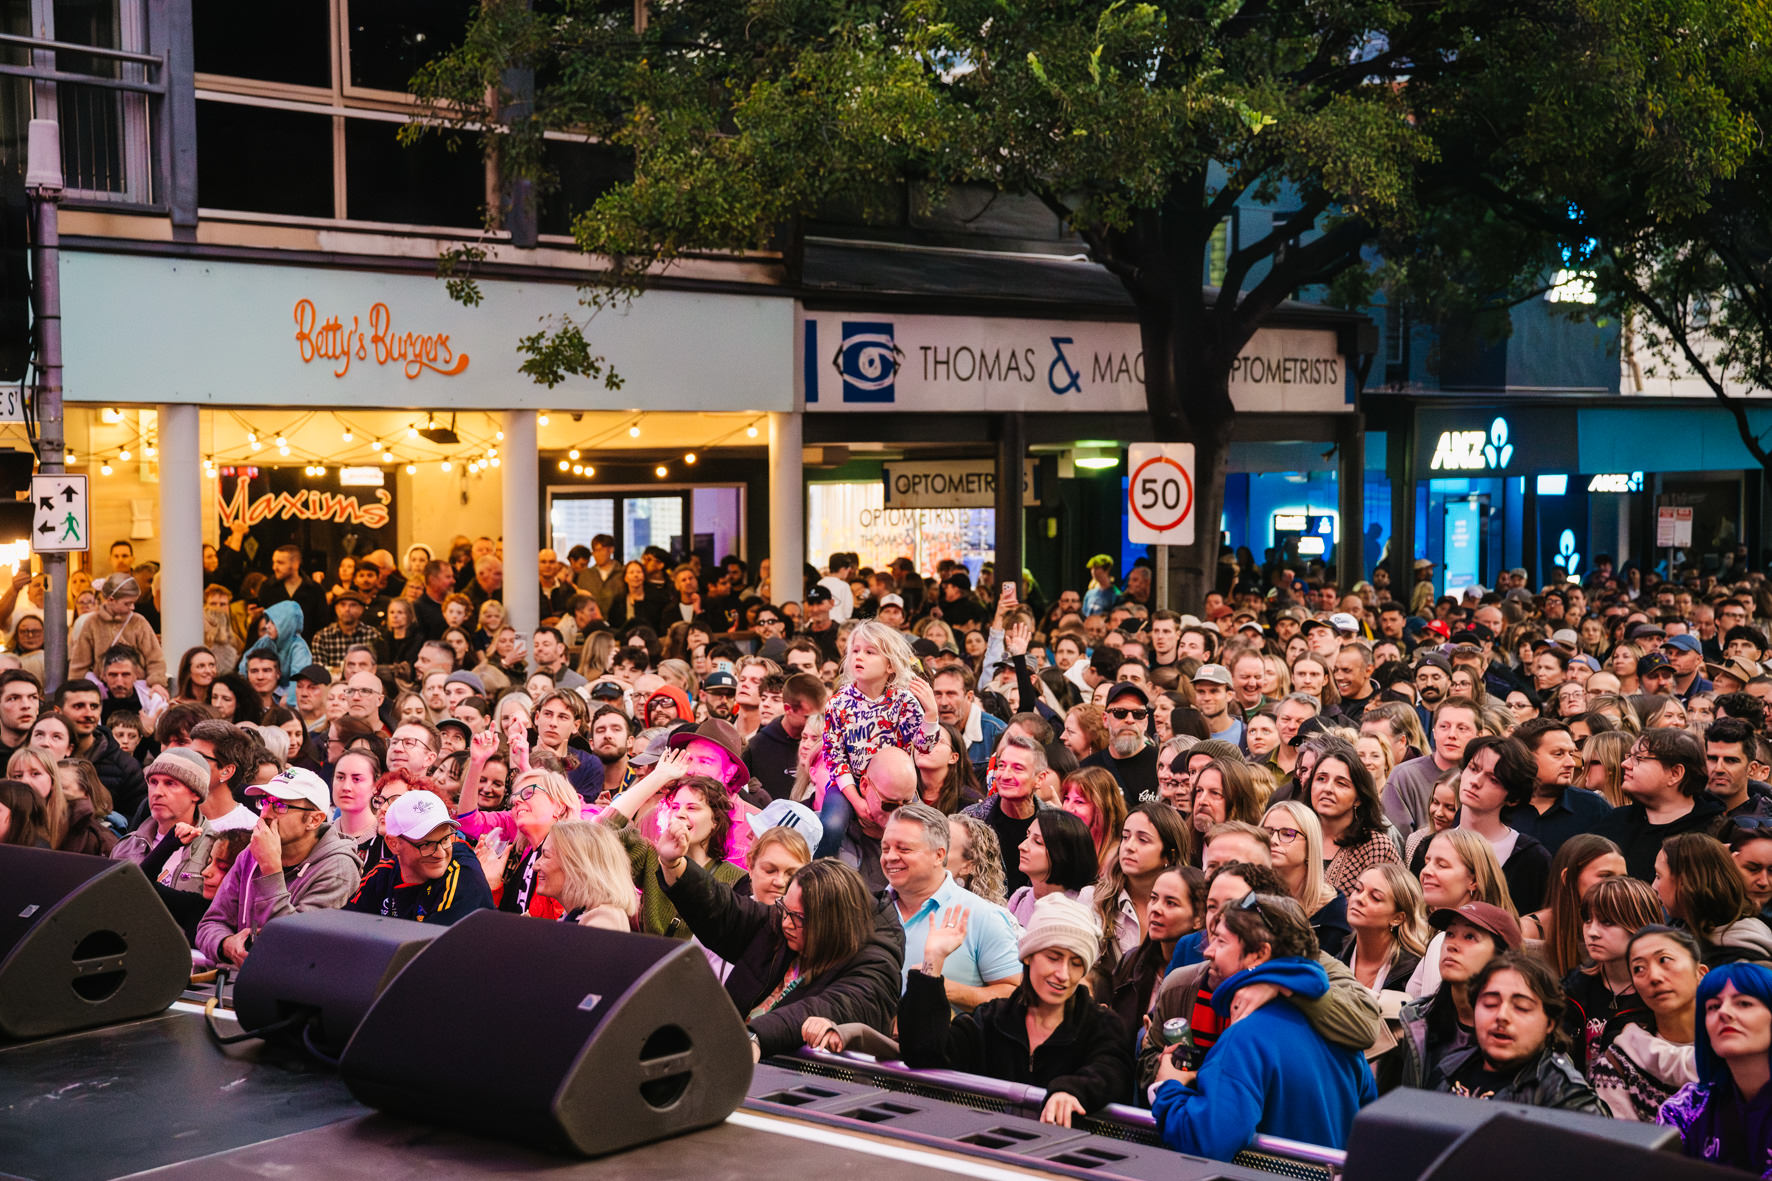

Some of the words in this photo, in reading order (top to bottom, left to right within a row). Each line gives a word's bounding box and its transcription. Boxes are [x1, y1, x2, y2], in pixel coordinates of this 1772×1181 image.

[294, 298, 367, 378] Betty's
[369, 302, 470, 380] Burgers
[919, 345, 1036, 382] THOMAS
[1048, 336, 1082, 395] &
[1231, 356, 1338, 385] PTOMETRISTS
[1430, 430, 1487, 470] ANZ
[218, 476, 392, 529] Maxims'
[1141, 478, 1181, 510] 50
[1587, 473, 1629, 493] ANZ
